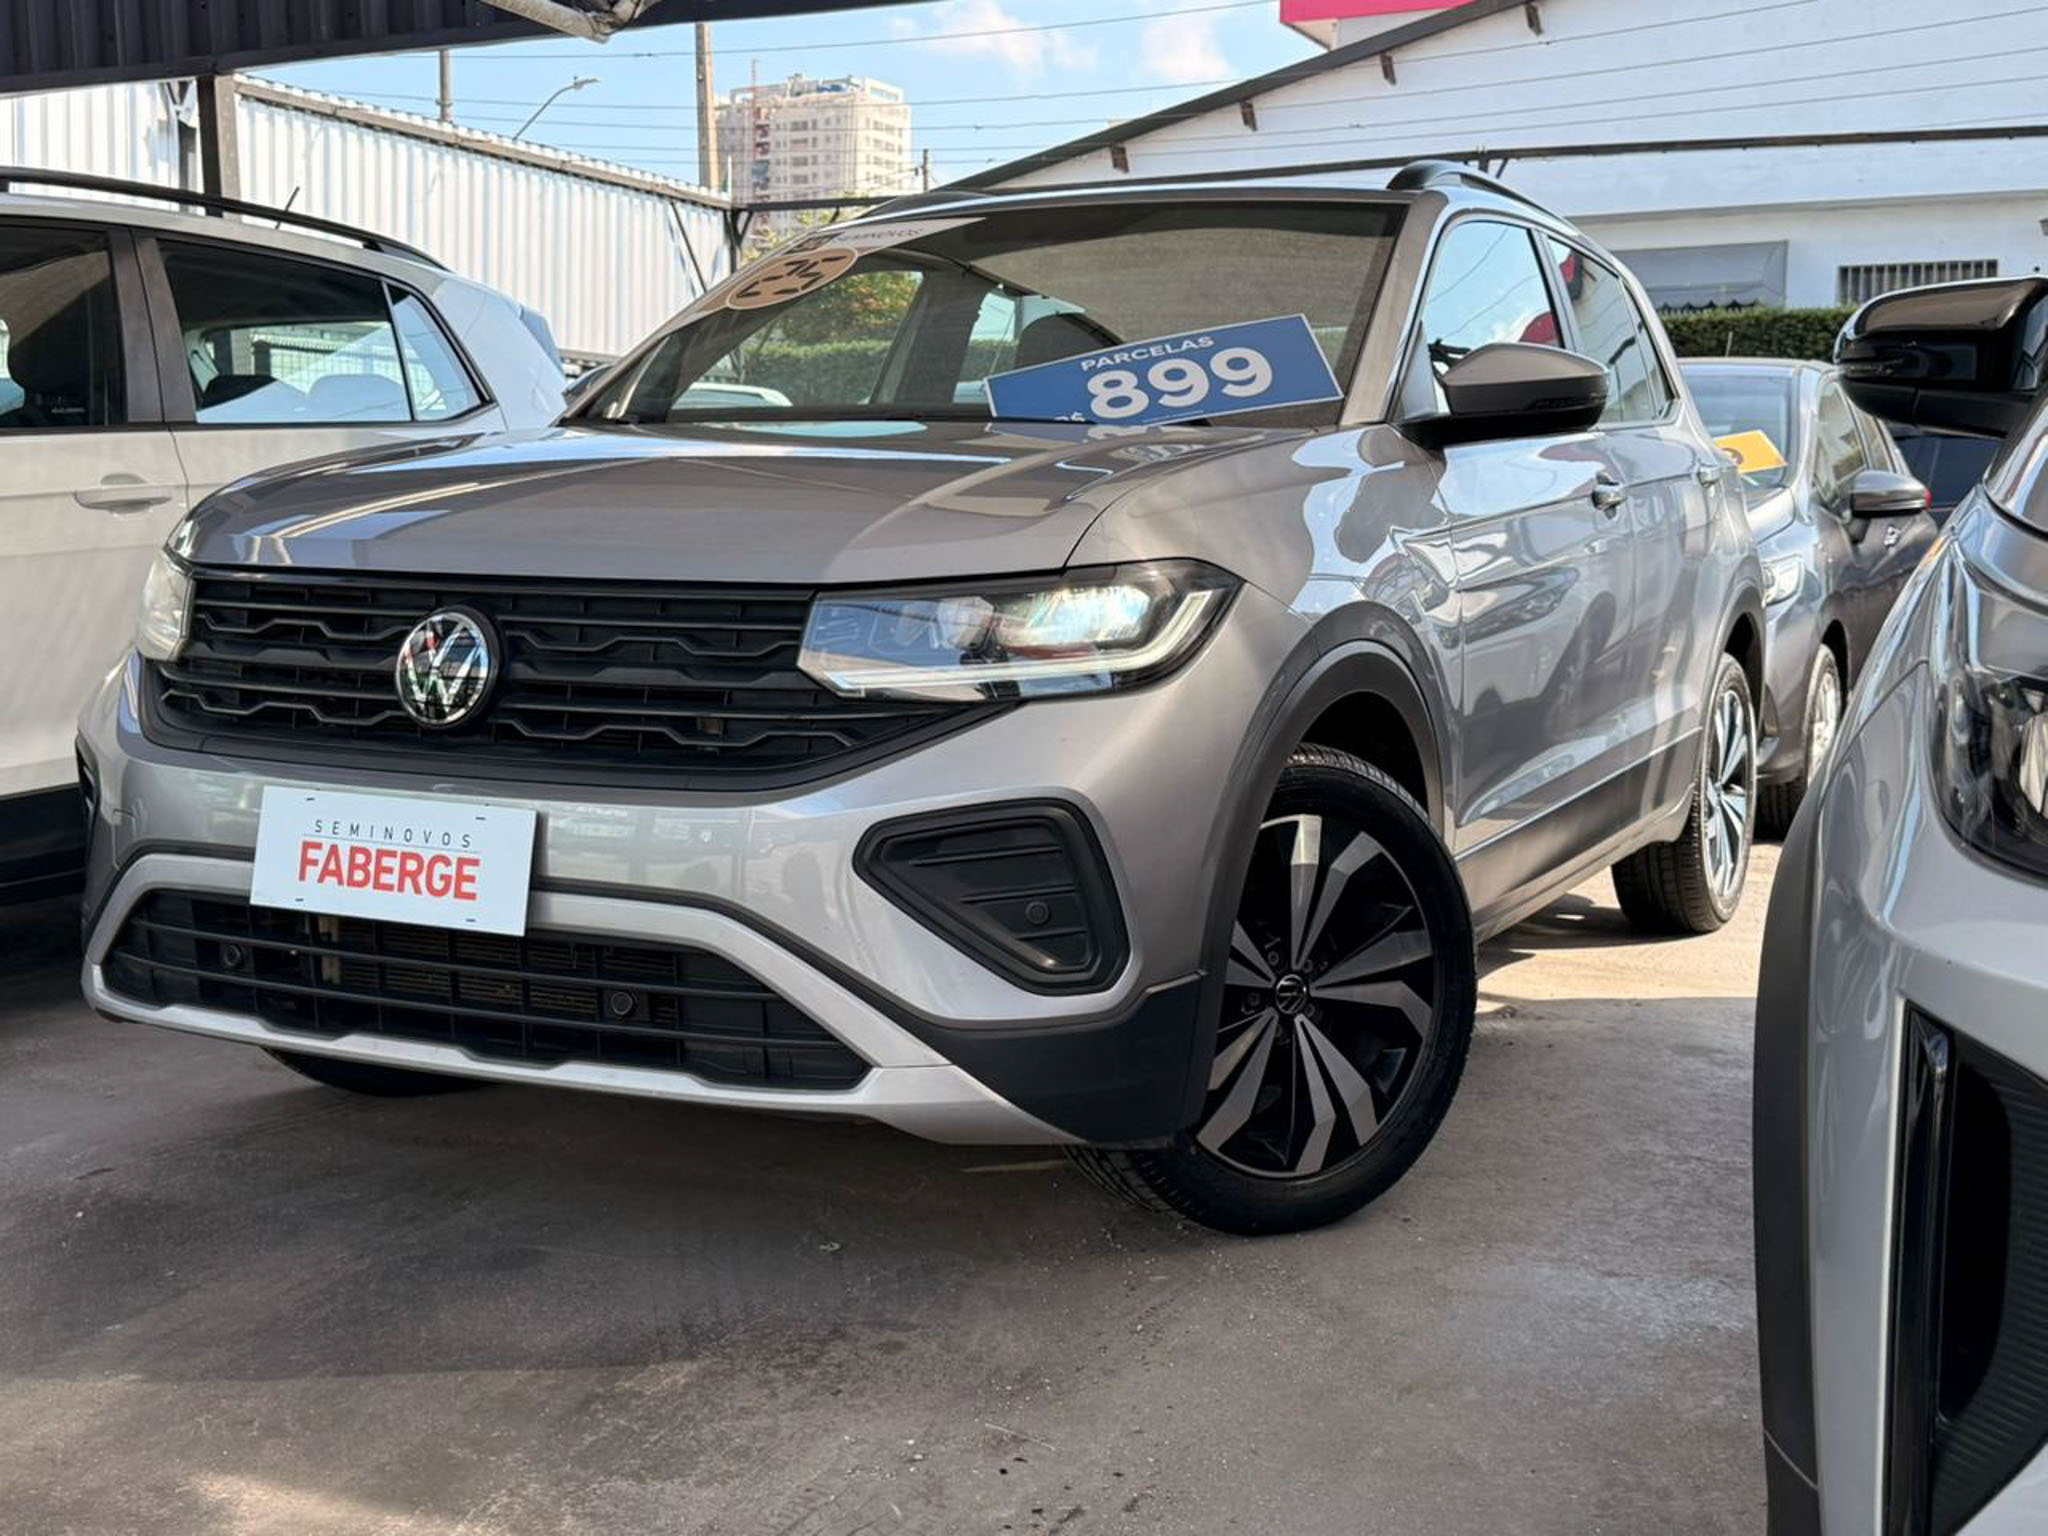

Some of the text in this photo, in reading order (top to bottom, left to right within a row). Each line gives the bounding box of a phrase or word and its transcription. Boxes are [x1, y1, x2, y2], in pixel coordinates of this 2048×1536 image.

[1081, 336, 1215, 372] PARCELAS
[1087, 347, 1273, 419] 899
[314, 819, 472, 849] SEMINOVOS
[297, 839, 481, 901] FABERGE
